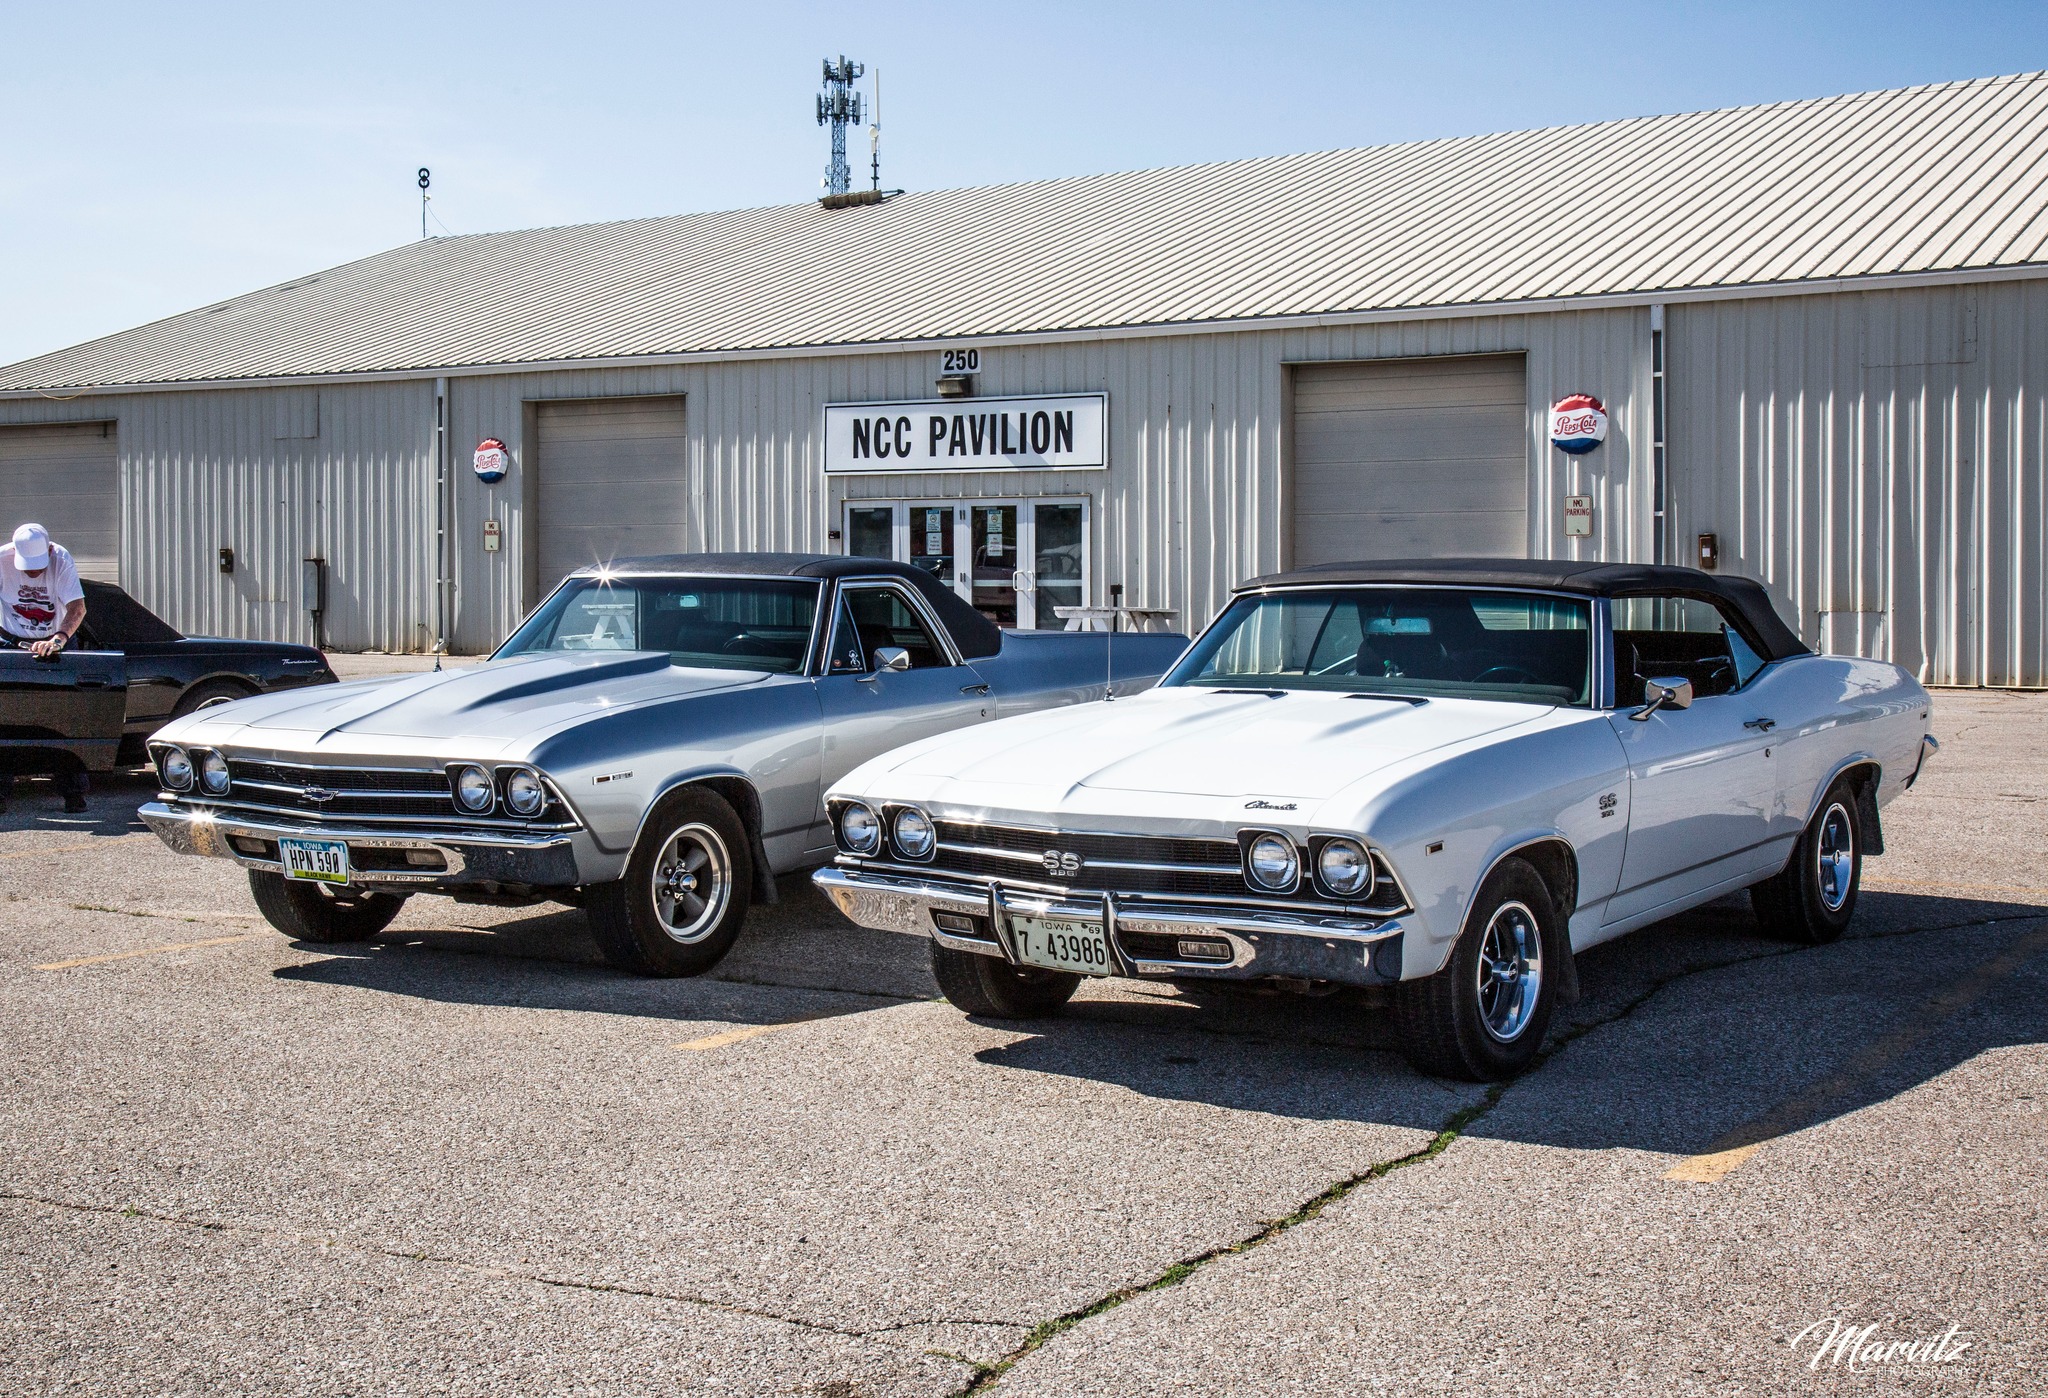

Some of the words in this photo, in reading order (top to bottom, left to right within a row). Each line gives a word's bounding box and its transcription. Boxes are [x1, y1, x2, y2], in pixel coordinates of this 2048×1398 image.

[944, 349, 978, 370] 250
[853, 416, 911, 458] NCC
[930, 411, 1073, 457] PAVILION
[1567, 508, 1590, 516] PARKING
[1599, 792, 1618, 810] SS
[303, 842, 323, 850] IOWA
[289, 849, 314, 871] HPN
[316, 851, 340, 874] 590
[1042, 850, 1082, 870] SS
[1041, 921, 1073, 932] IOWA
[1088, 926, 1100, 934] 69
